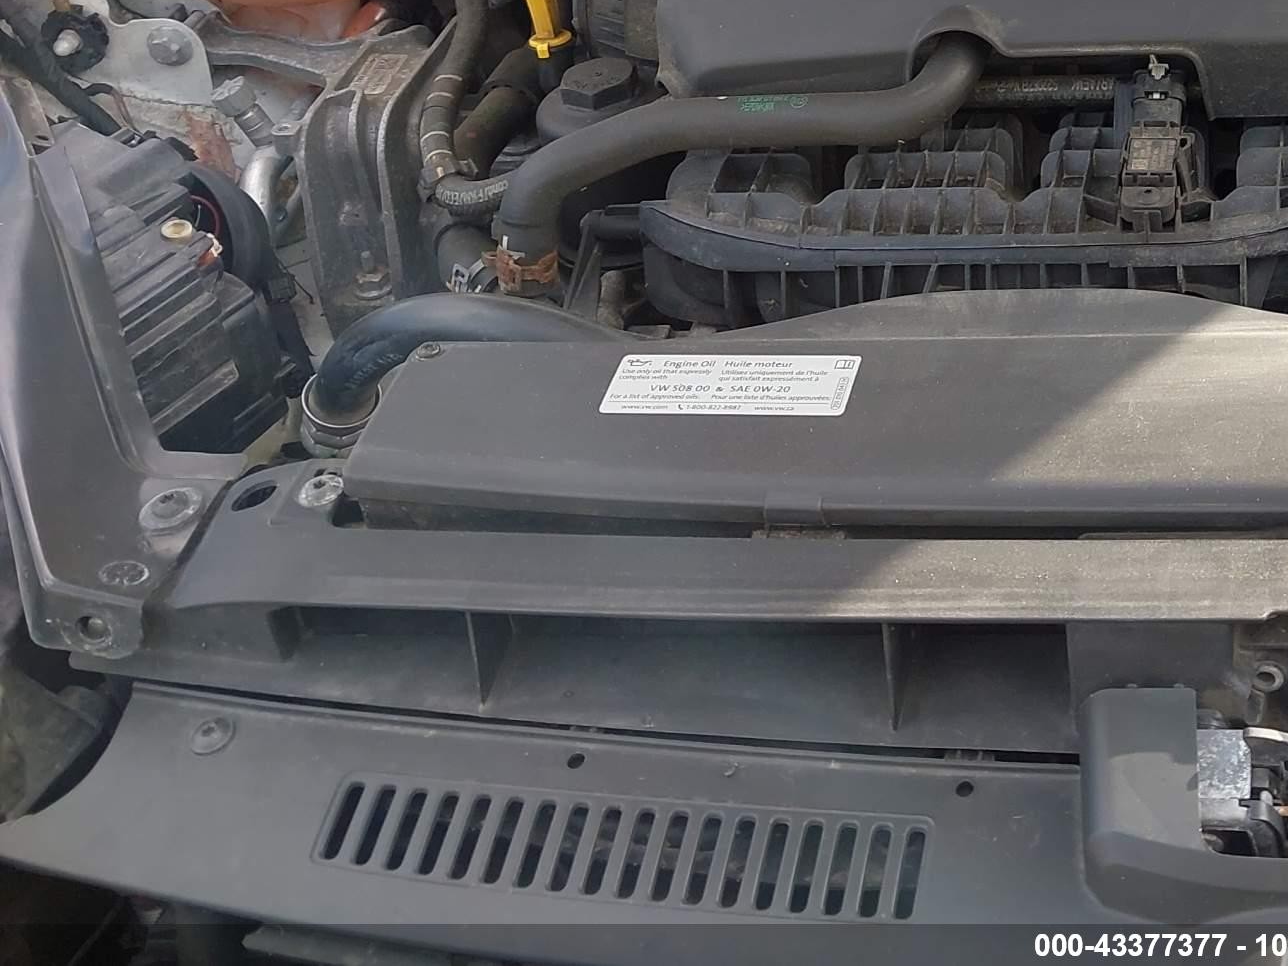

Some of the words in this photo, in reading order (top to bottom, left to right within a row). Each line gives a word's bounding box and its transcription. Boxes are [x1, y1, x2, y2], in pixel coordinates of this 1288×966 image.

[663, 360, 699, 369] Engine
[724, 360, 753, 368] Huile
[650, 384, 670, 392] VW
[672, 384, 693, 392] 508
[729, 385, 752, 393] SAE
[753, 385, 792, 393] 0W-20
